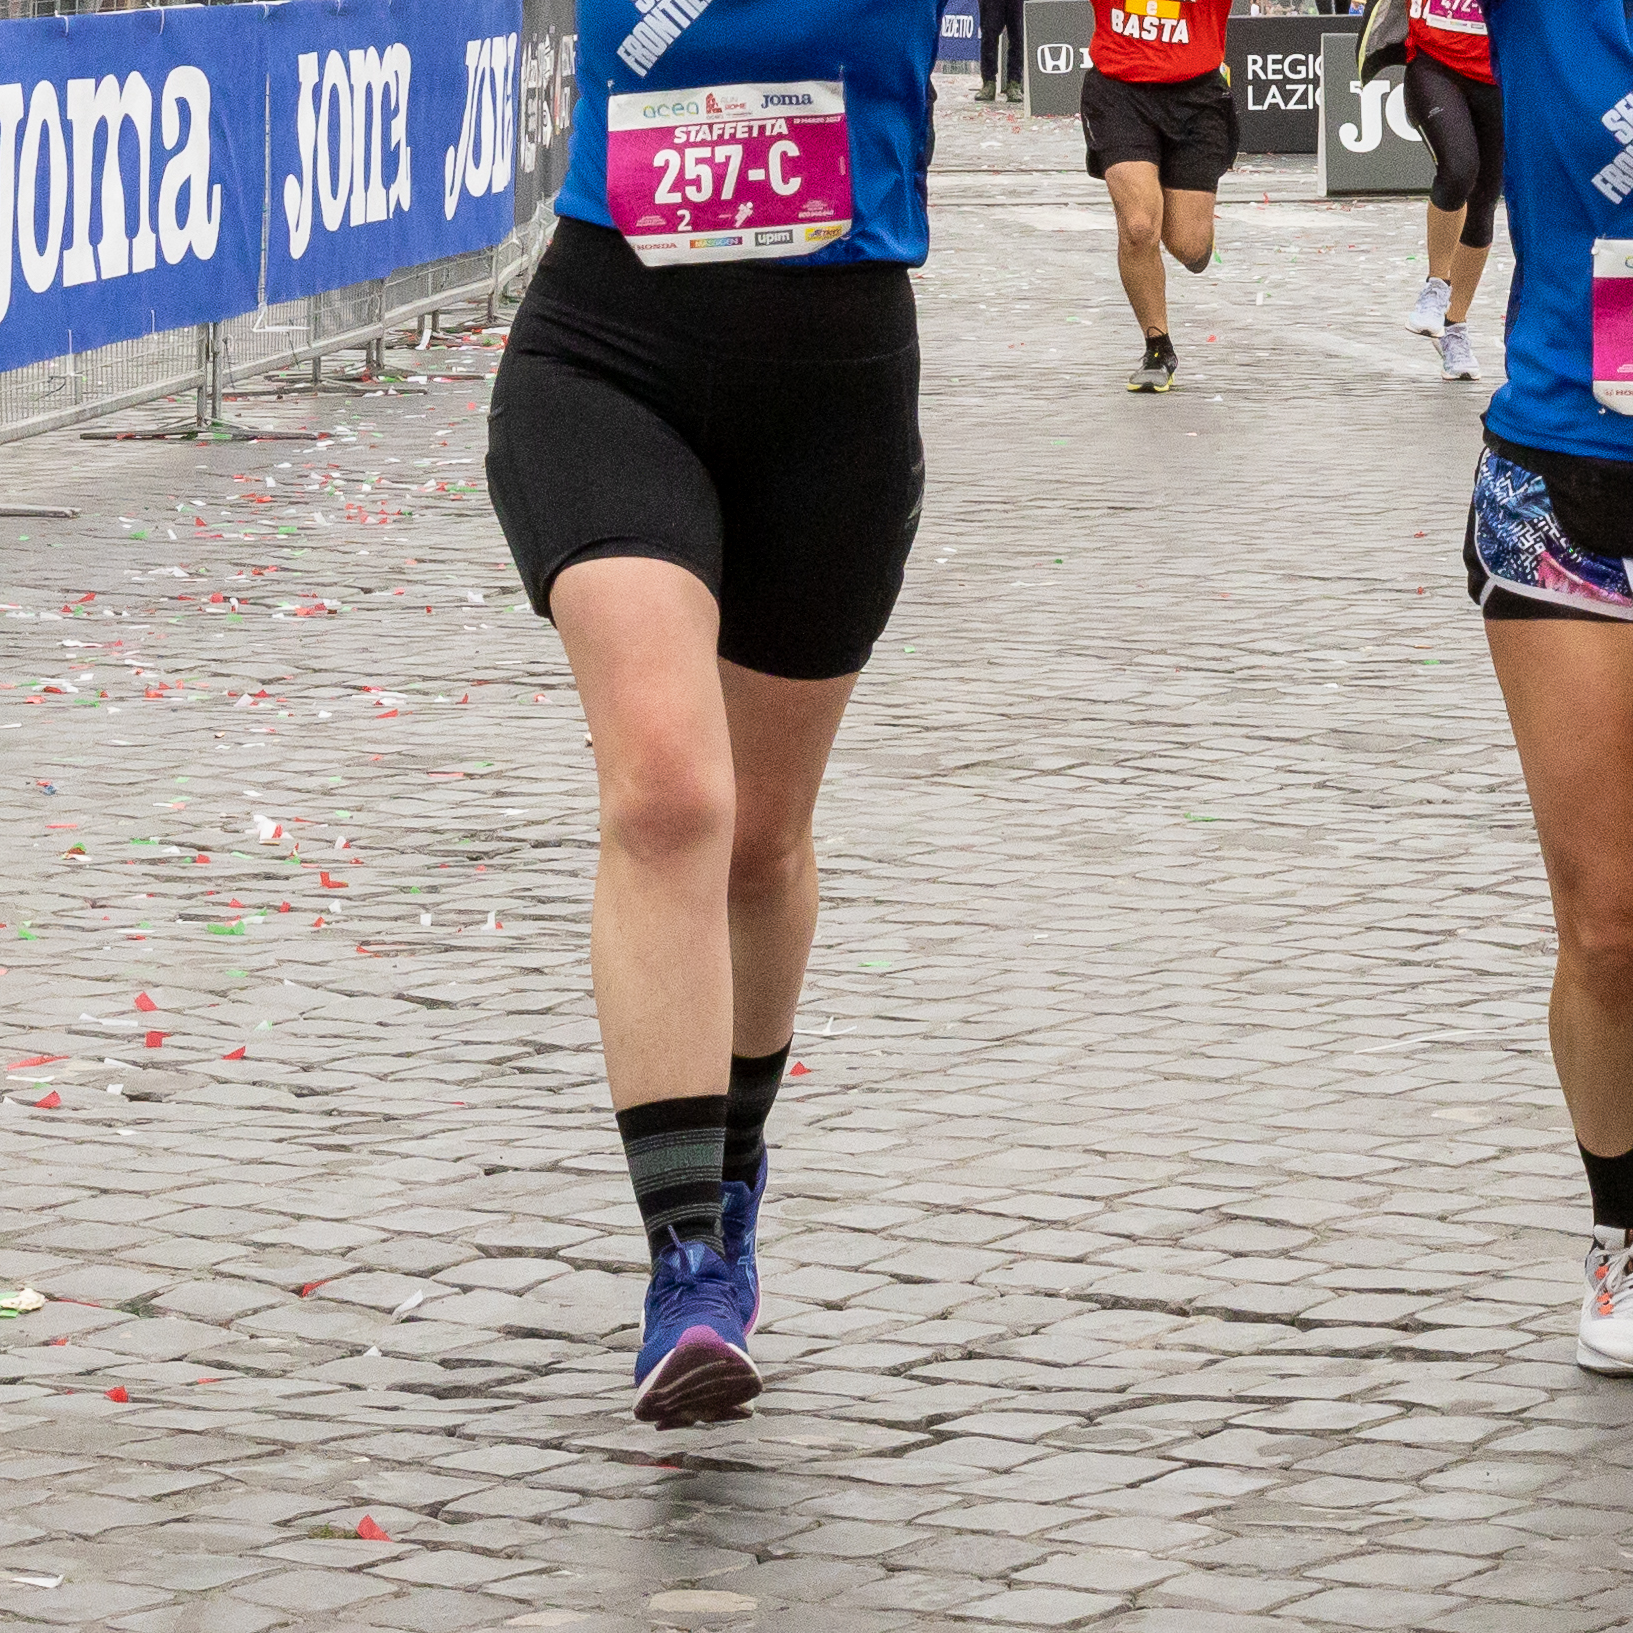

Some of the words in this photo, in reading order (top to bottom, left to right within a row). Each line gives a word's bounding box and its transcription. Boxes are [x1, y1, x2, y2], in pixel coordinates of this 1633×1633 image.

[1111, 7, 1190, 44] BASTA
[643, 101, 700, 119] acea
[673, 118, 789, 144] STAFFETTA
[653, 139, 803, 205] 257-C
[676, 209, 693, 232] 2
